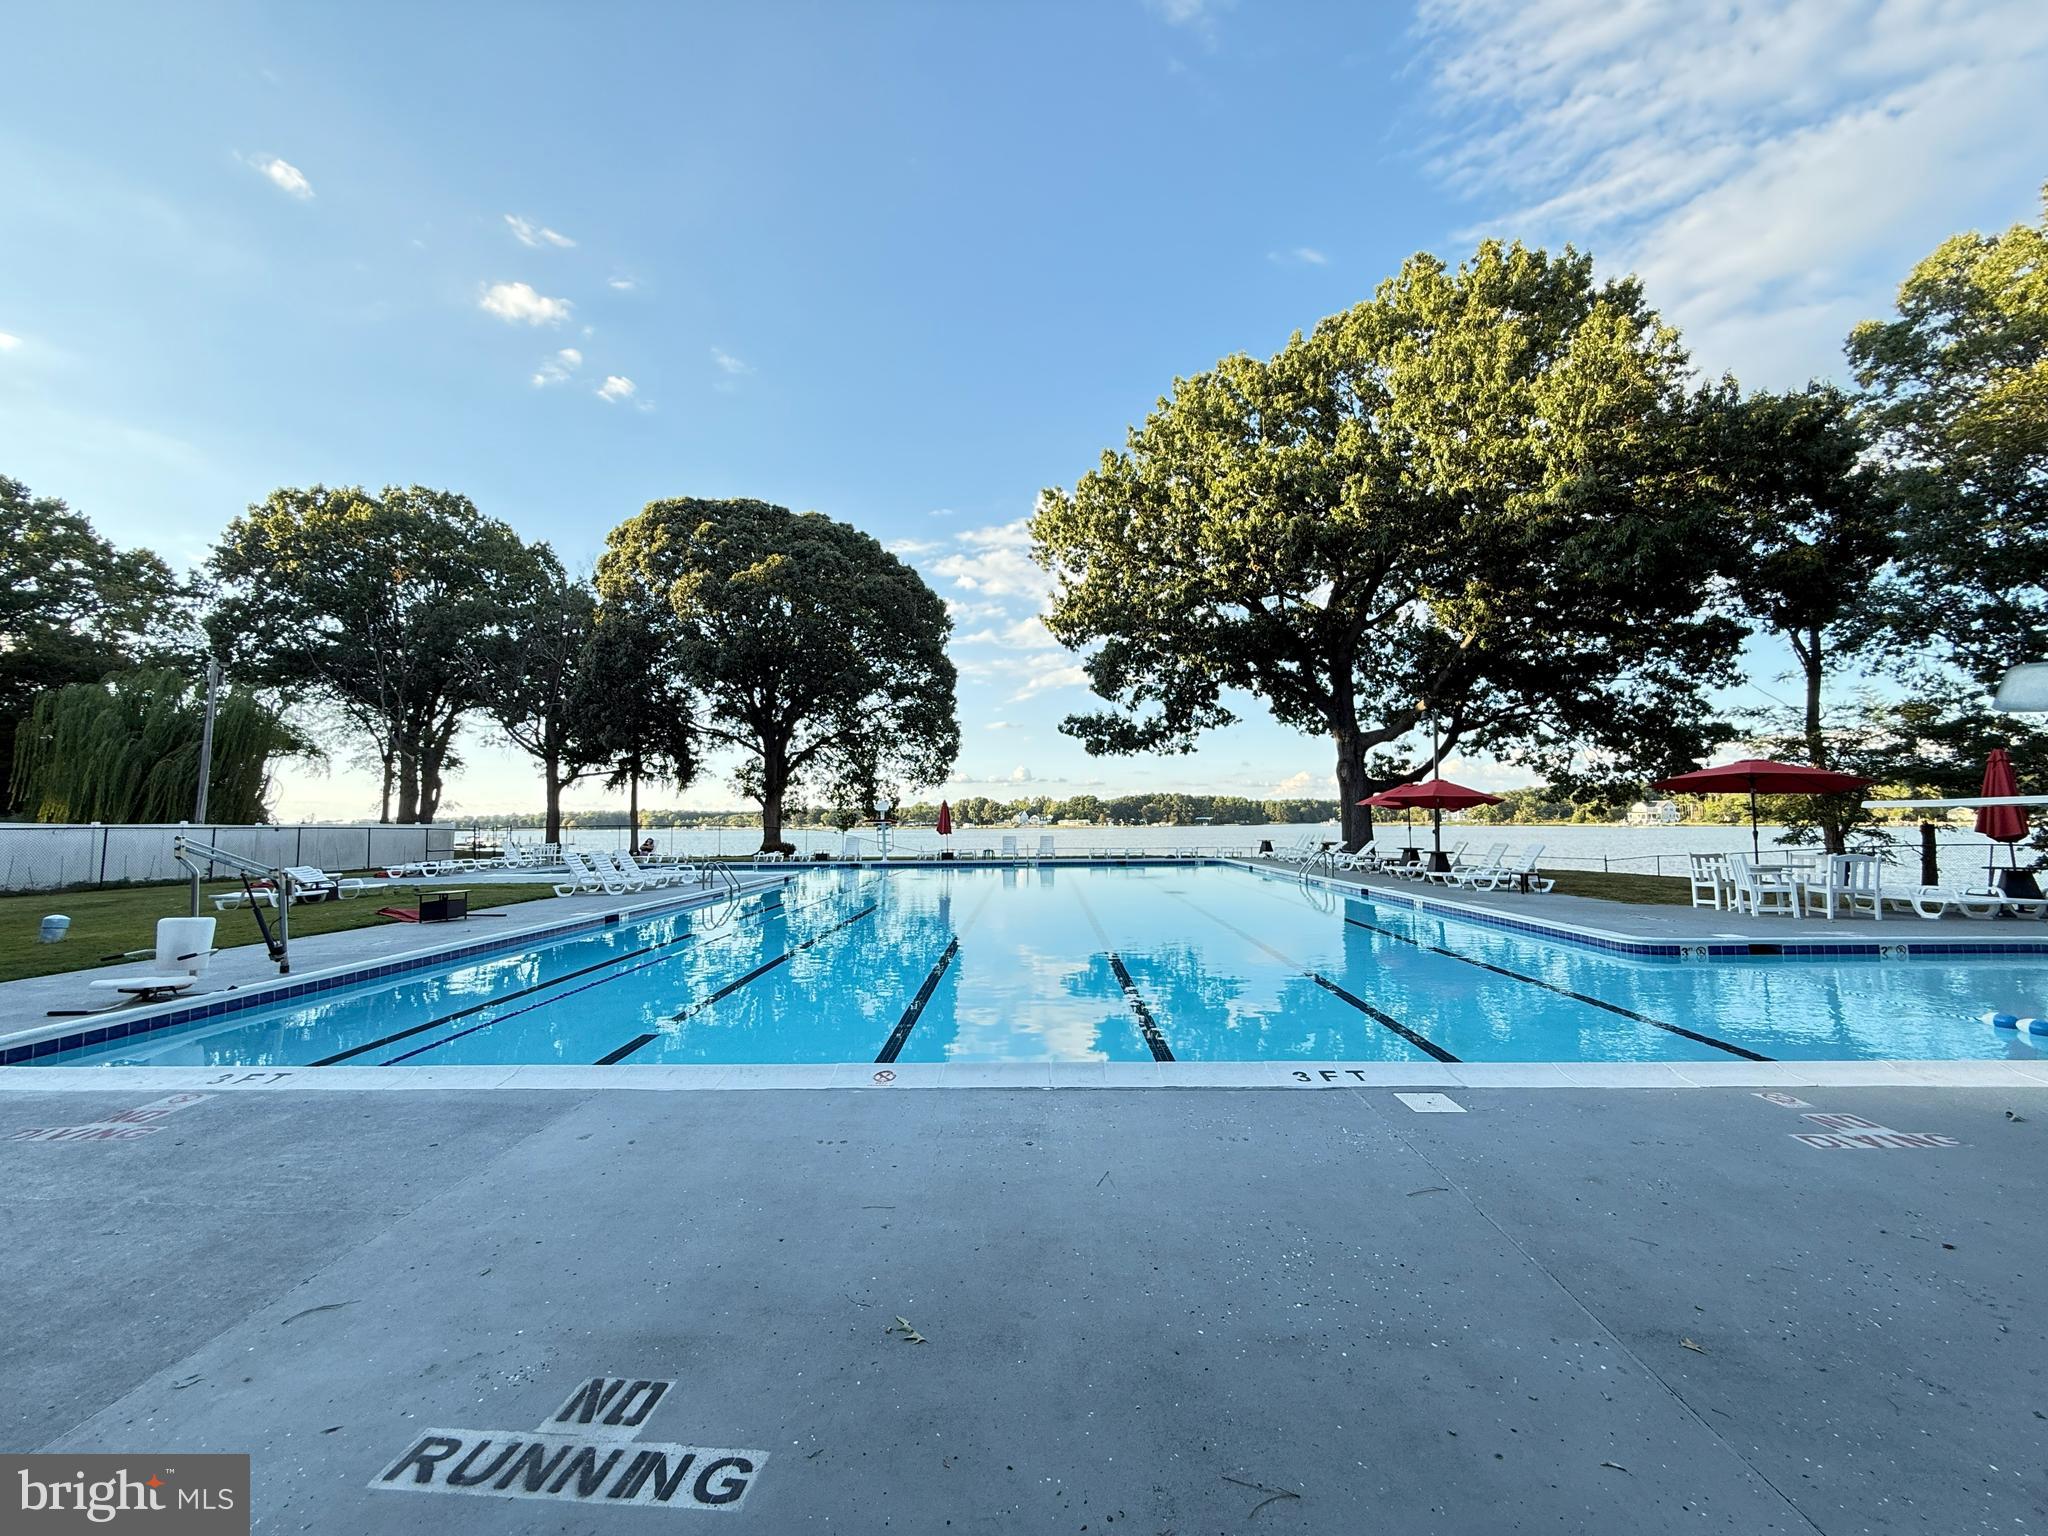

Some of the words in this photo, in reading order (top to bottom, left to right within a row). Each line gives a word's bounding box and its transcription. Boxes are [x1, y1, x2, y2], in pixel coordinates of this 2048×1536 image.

[96, 1110, 170, 1124] NO
[1806, 1115, 1881, 1129] NO
[8, 1128, 158, 1140] DIVING
[1799, 1134, 1961, 1148] DIVING
[556, 1378, 669, 1426] NO
[383, 1436, 753, 1505] RUNNING
